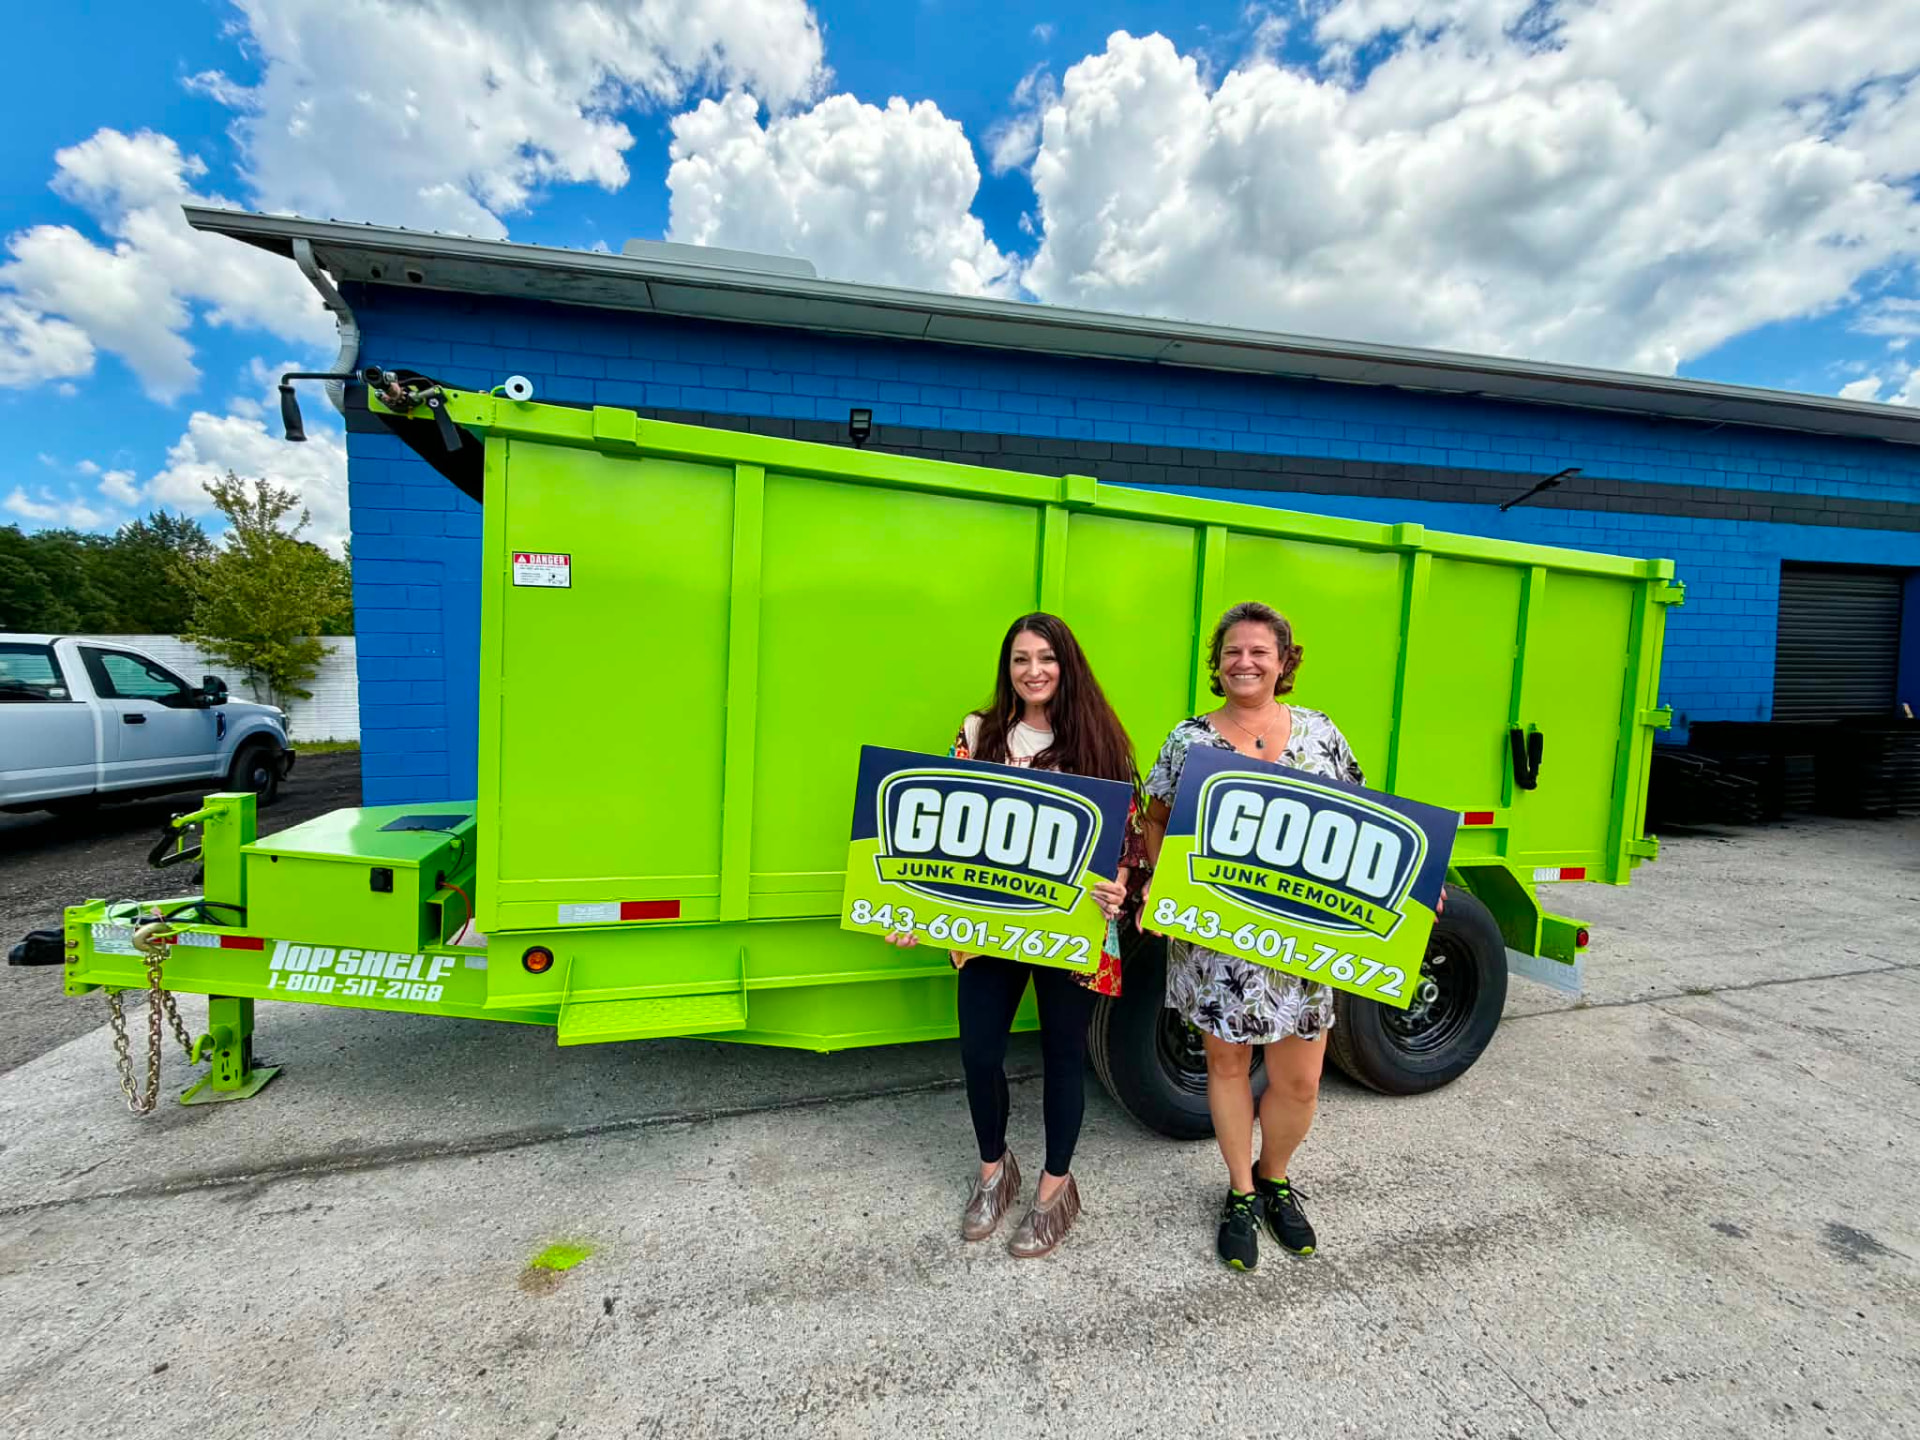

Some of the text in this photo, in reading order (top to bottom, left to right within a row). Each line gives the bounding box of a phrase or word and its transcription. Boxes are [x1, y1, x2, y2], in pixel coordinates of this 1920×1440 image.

[530, 555, 565, 565] DANGER
[895, 788, 1078, 876] GOOD
[1210, 789, 1401, 899] GOOD
[897, 862, 1058, 901] JUNK REMOVAL
[1209, 865, 1375, 925] JUNK REMOVAL
[851, 899, 1091, 964] 843-601-7672
[1153, 898, 1406, 998] 843-601-7672
[267, 972, 444, 1002] 1-800-511-2168
[334, 949, 456, 982] SHELF
